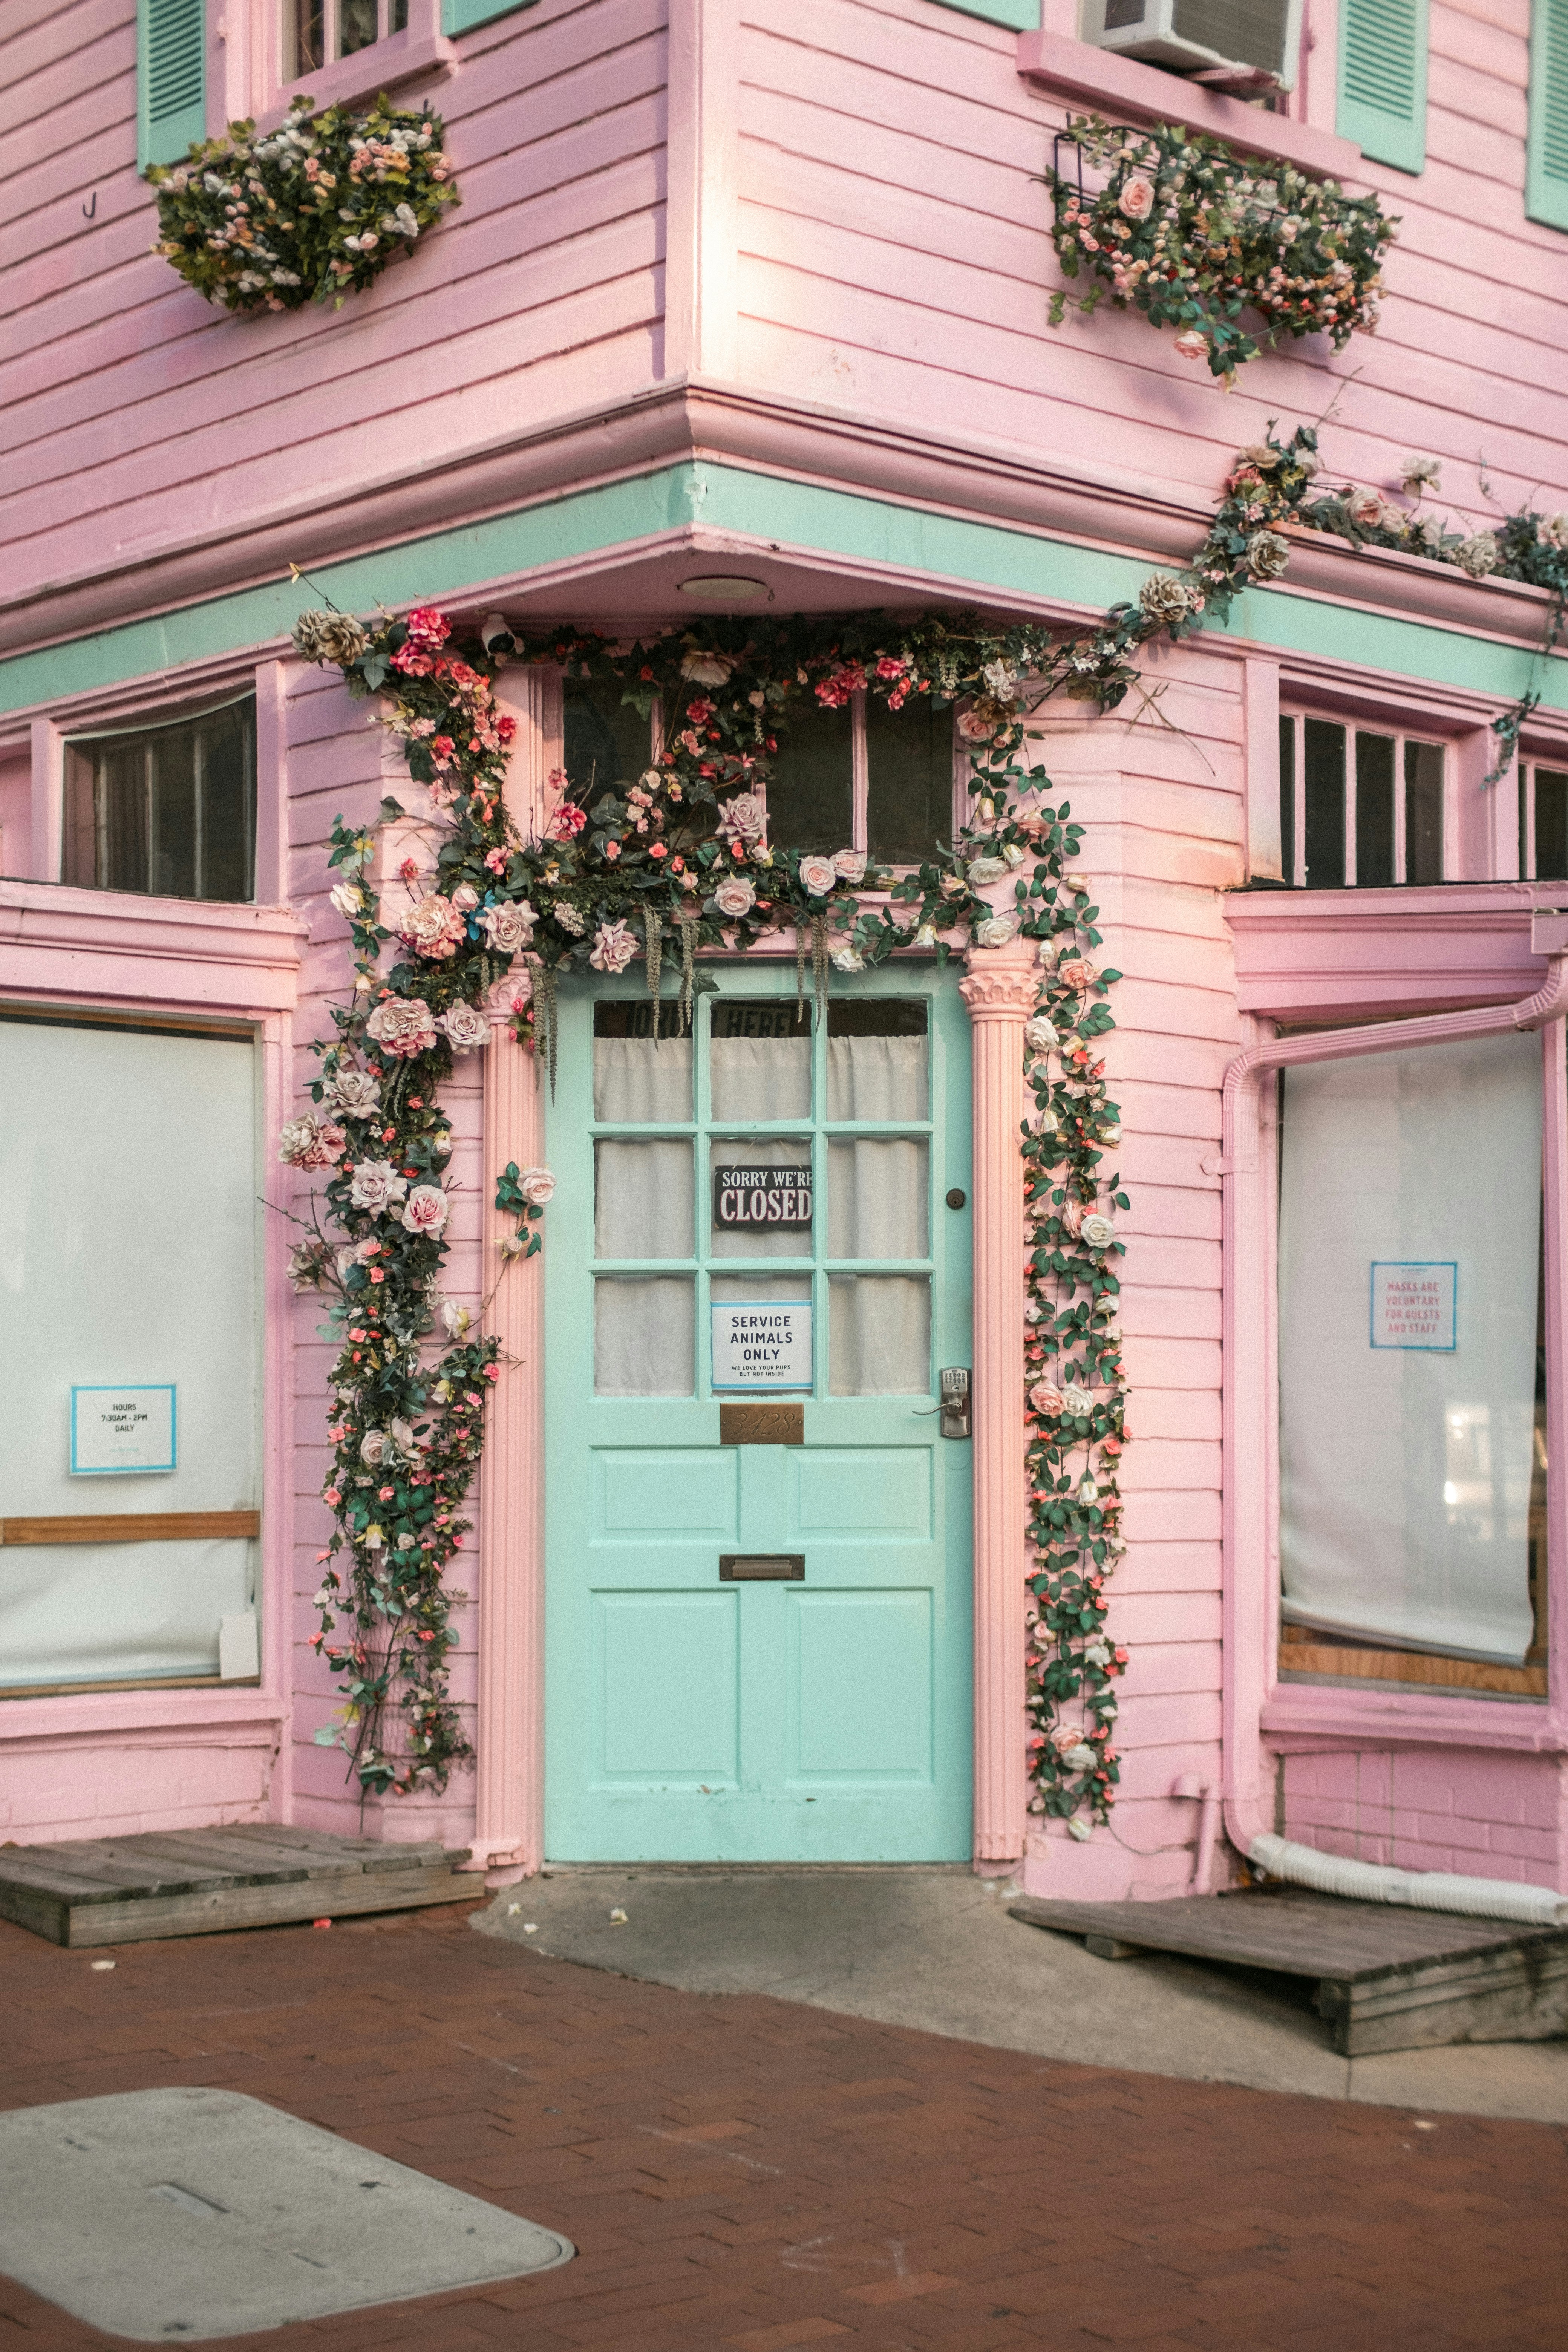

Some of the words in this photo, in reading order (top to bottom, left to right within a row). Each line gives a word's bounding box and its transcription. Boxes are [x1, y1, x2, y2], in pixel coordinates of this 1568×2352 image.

[723, 1171, 768, 1186] SORRY
[720, 1189, 812, 1221] CLOSED
[1421, 1282, 1438, 1292] ARE
[732, 1315, 791, 1327] SERVICE
[1388, 1323, 1406, 1332] AND
[1409, 1323, 1437, 1332] STAFF
[730, 1332, 793, 1344] ANIMALS
[744, 1349, 780, 1360] ONLY
[729, 1412, 796, 1435] 3428
